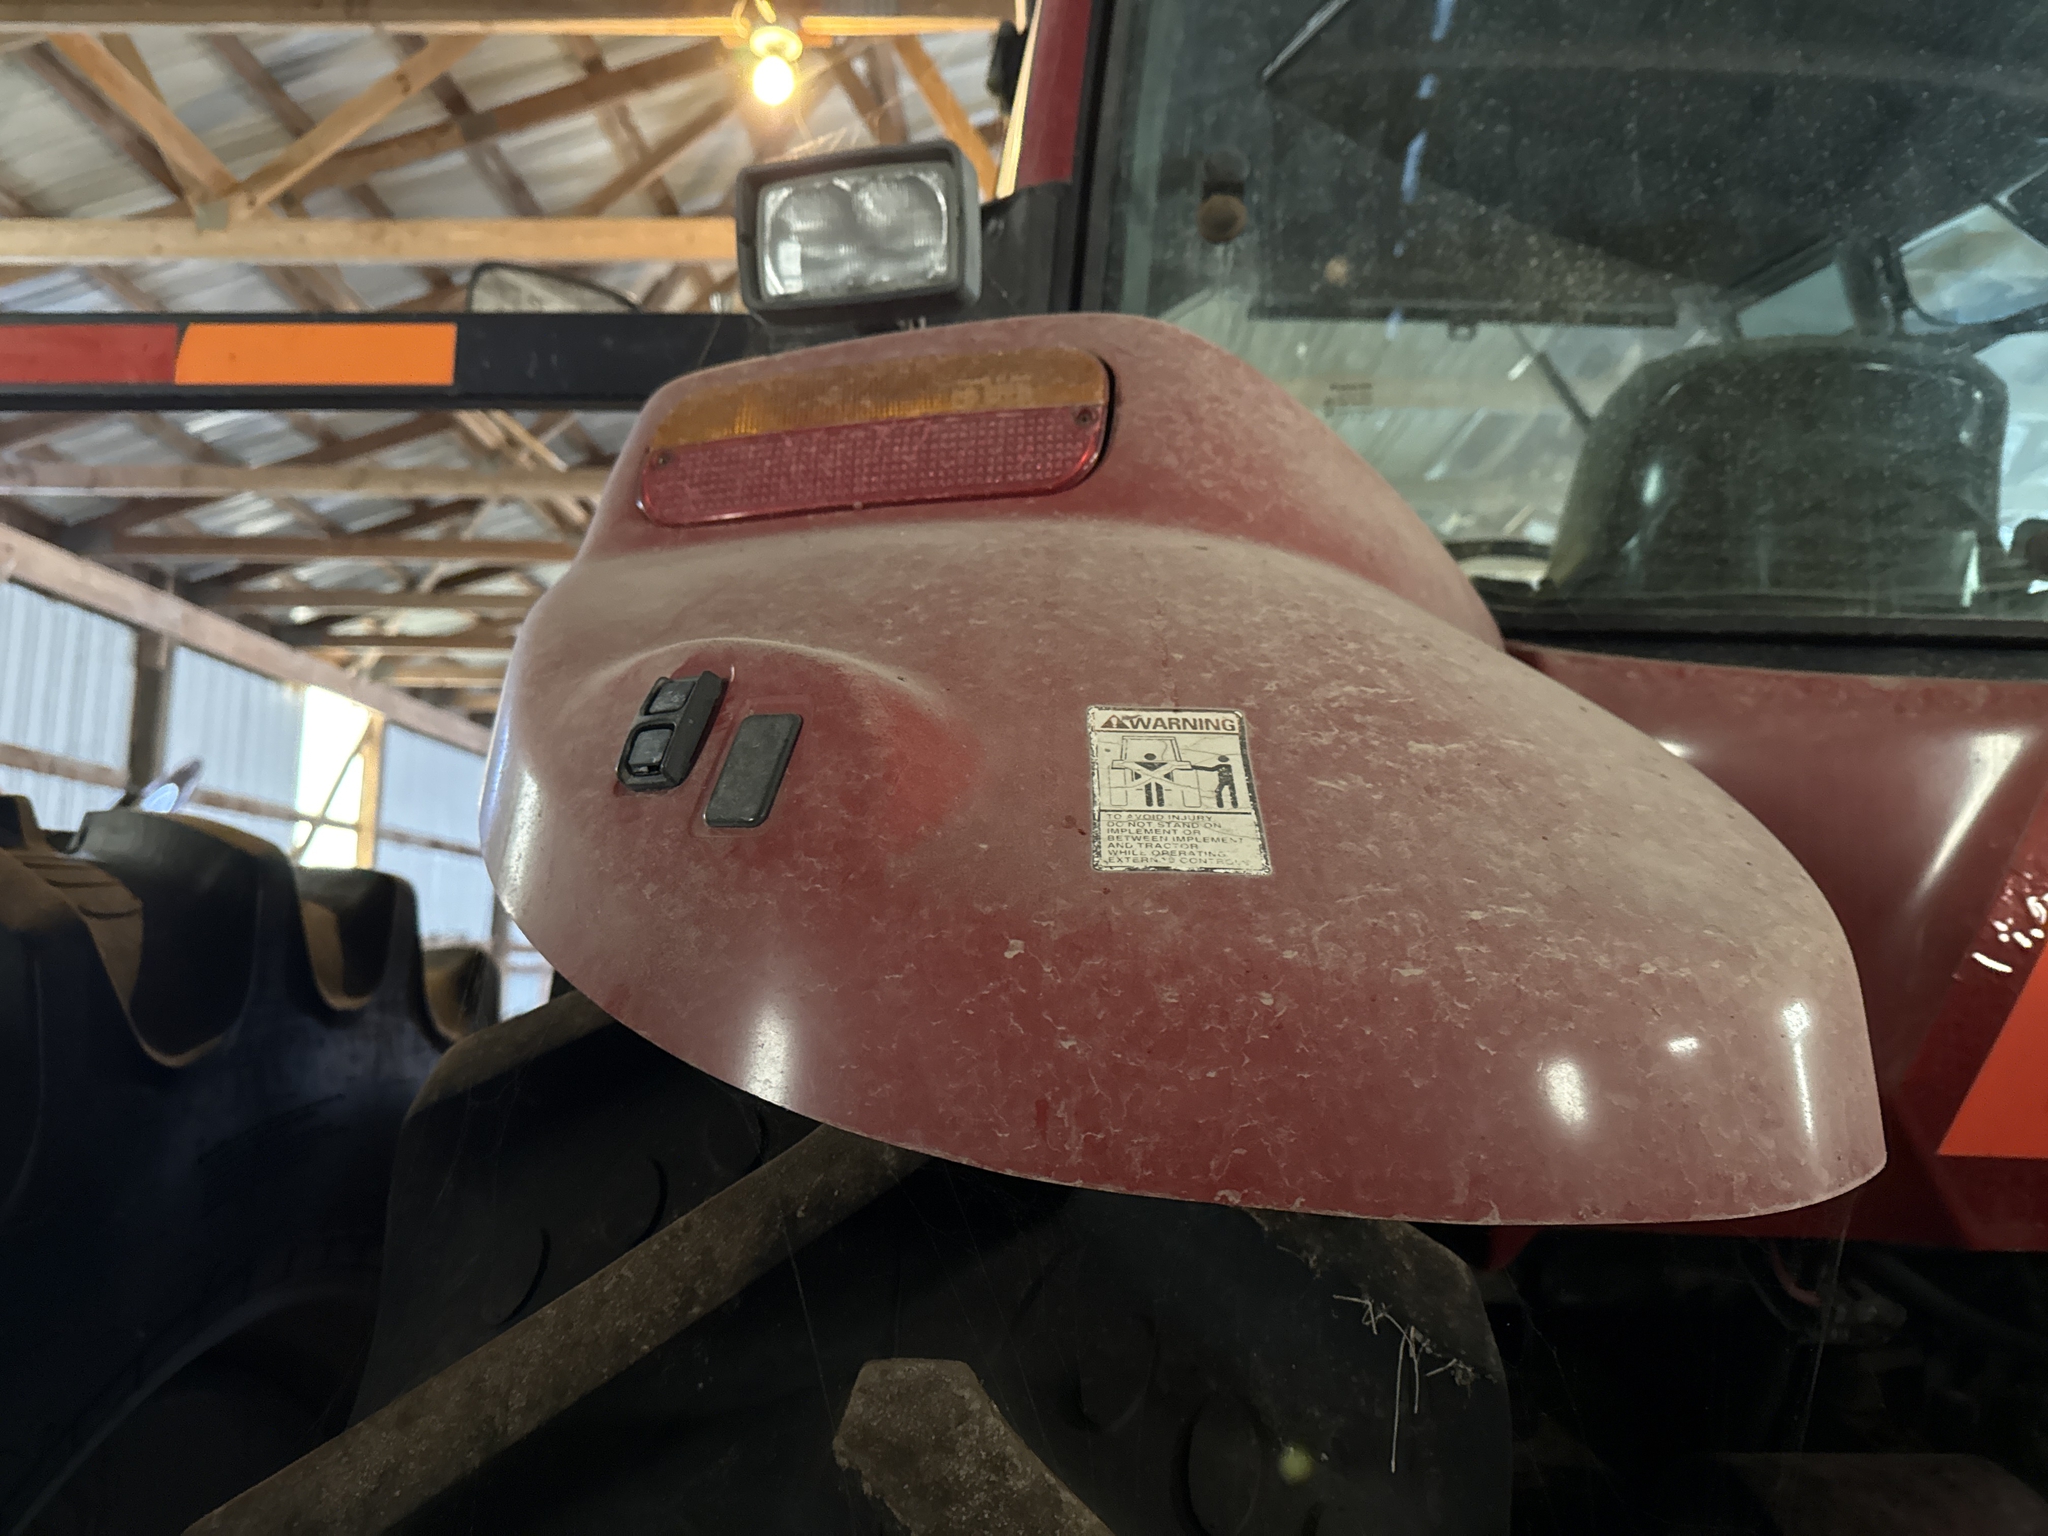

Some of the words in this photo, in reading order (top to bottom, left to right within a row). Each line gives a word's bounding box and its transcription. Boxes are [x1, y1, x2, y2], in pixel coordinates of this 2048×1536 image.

[1129, 717, 1236, 731] WARNING
[1157, 821, 1200, 829] STAND
[1151, 849, 1227, 857] OPERATING
